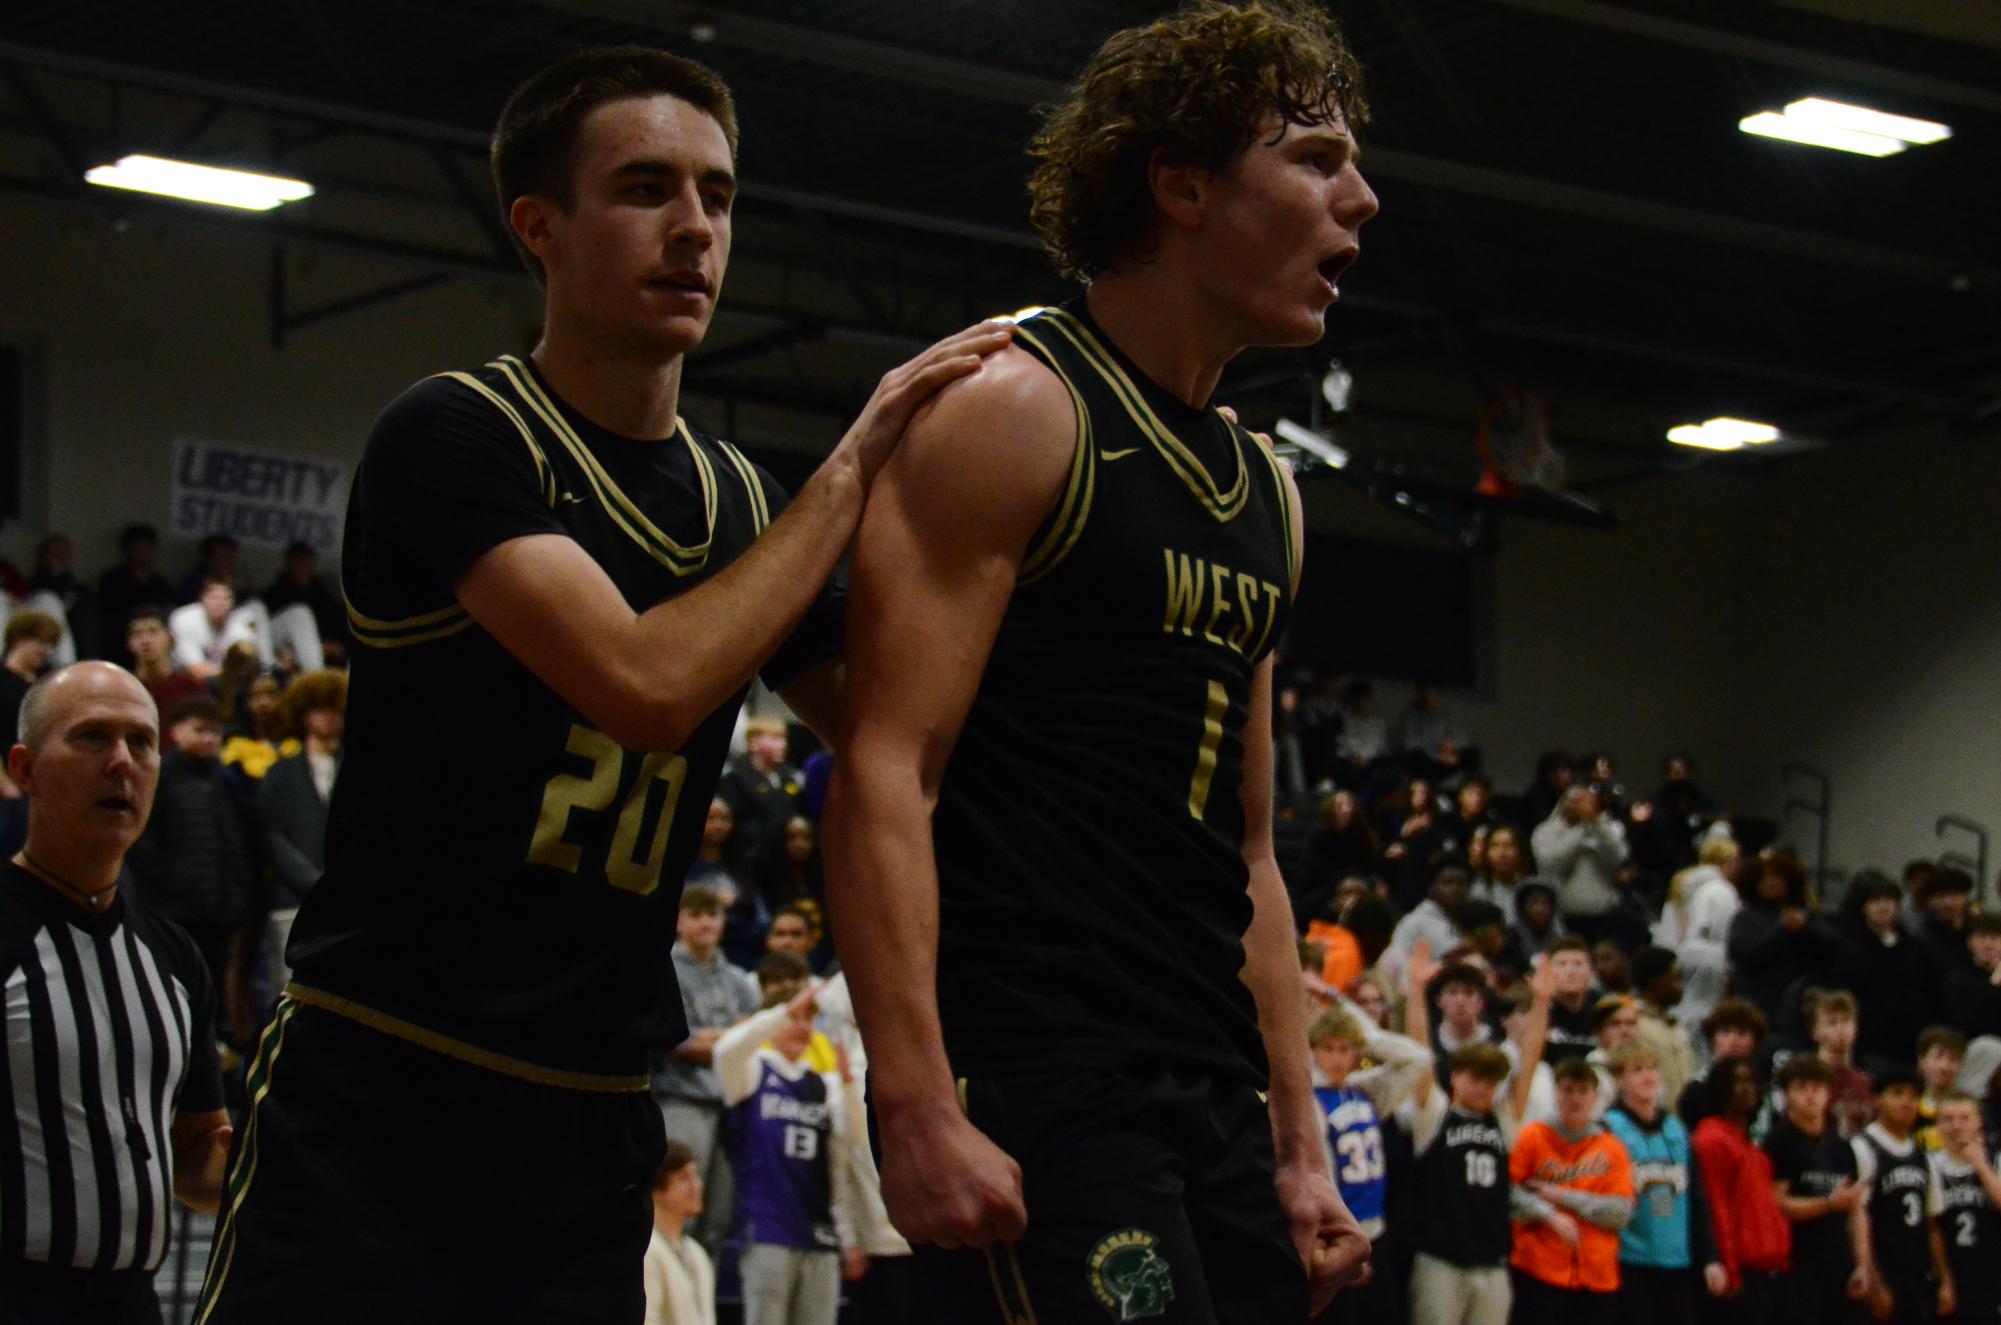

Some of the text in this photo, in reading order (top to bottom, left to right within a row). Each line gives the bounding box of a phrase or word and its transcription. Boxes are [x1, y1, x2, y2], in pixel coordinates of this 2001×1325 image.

[179, 445, 344, 503] LIBERTY
[179, 497, 337, 549] STUDENTS
[1162, 547, 1281, 661] WEST
[1188, 678, 1229, 822] 1
[526, 722, 688, 896] 20
[783, 1123, 819, 1161] 13
[1337, 1125, 1386, 1185] 33
[1902, 1191, 1923, 1228] 3
[1955, 1210, 1978, 1248] 2
